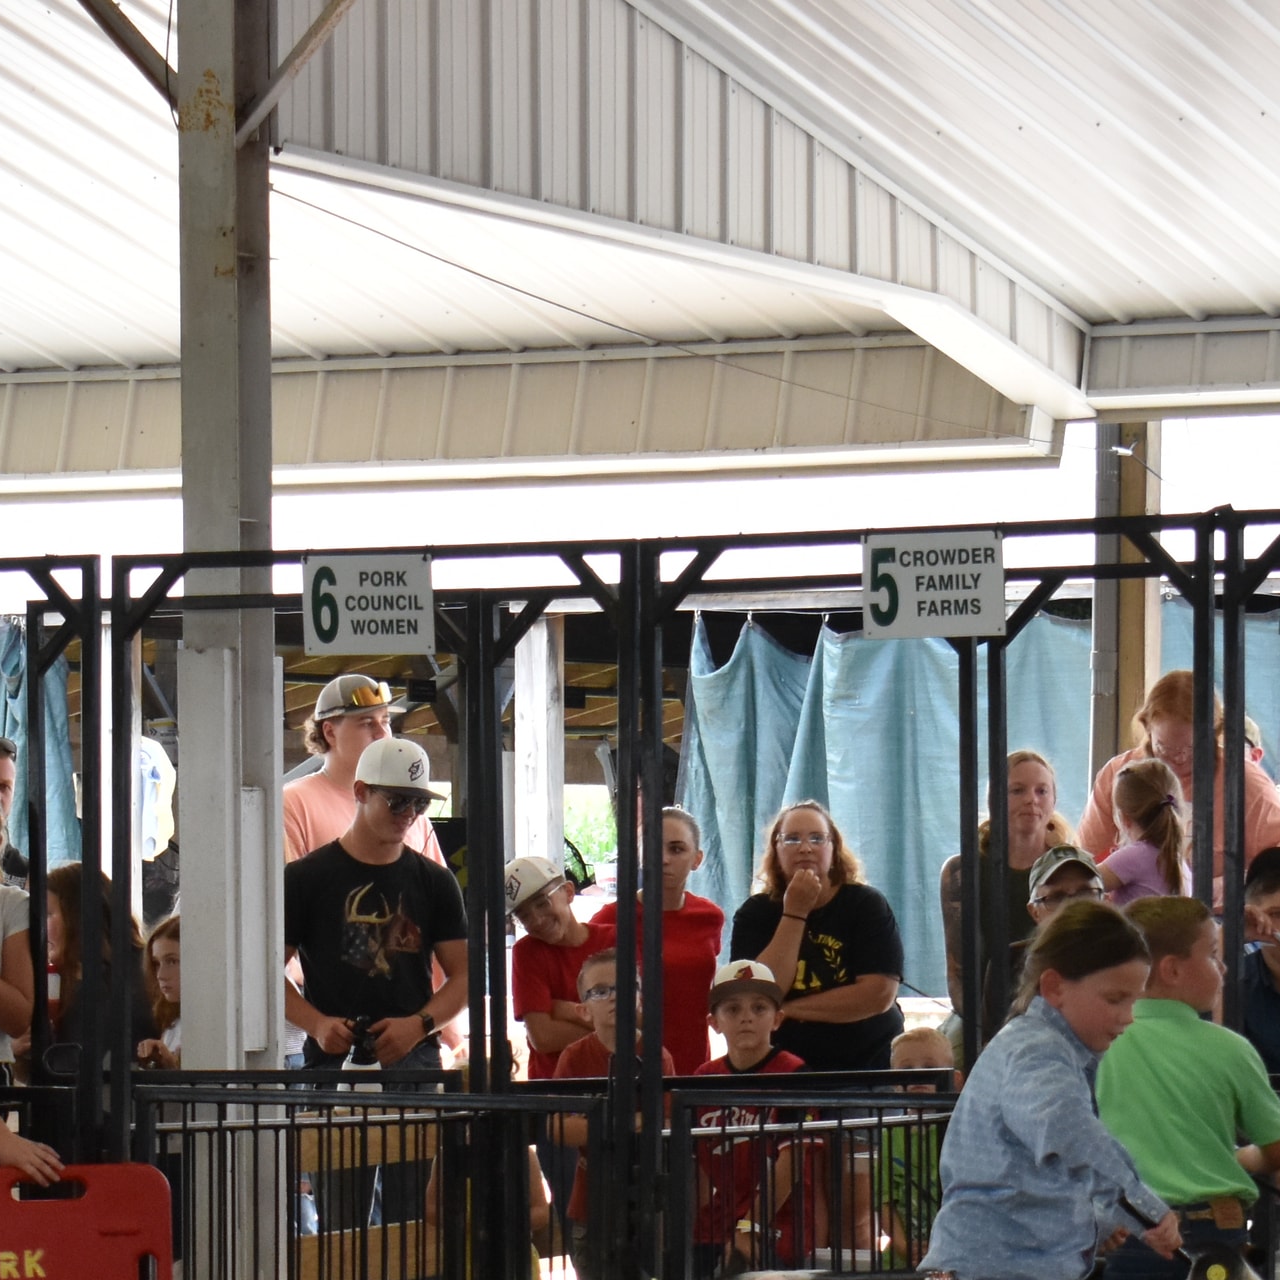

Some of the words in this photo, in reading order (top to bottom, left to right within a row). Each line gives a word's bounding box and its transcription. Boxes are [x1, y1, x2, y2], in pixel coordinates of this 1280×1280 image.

[899, 548, 995, 568] CROWDER
[360, 571, 407, 587] PORK
[870, 548, 899, 626] 5
[916, 573, 981, 592] FAMILY
[311, 566, 339, 643] 6
[345, 594, 423, 612] COUNCIL
[917, 598, 981, 617] FARMS
[351, 618, 418, 635] WOMEN
